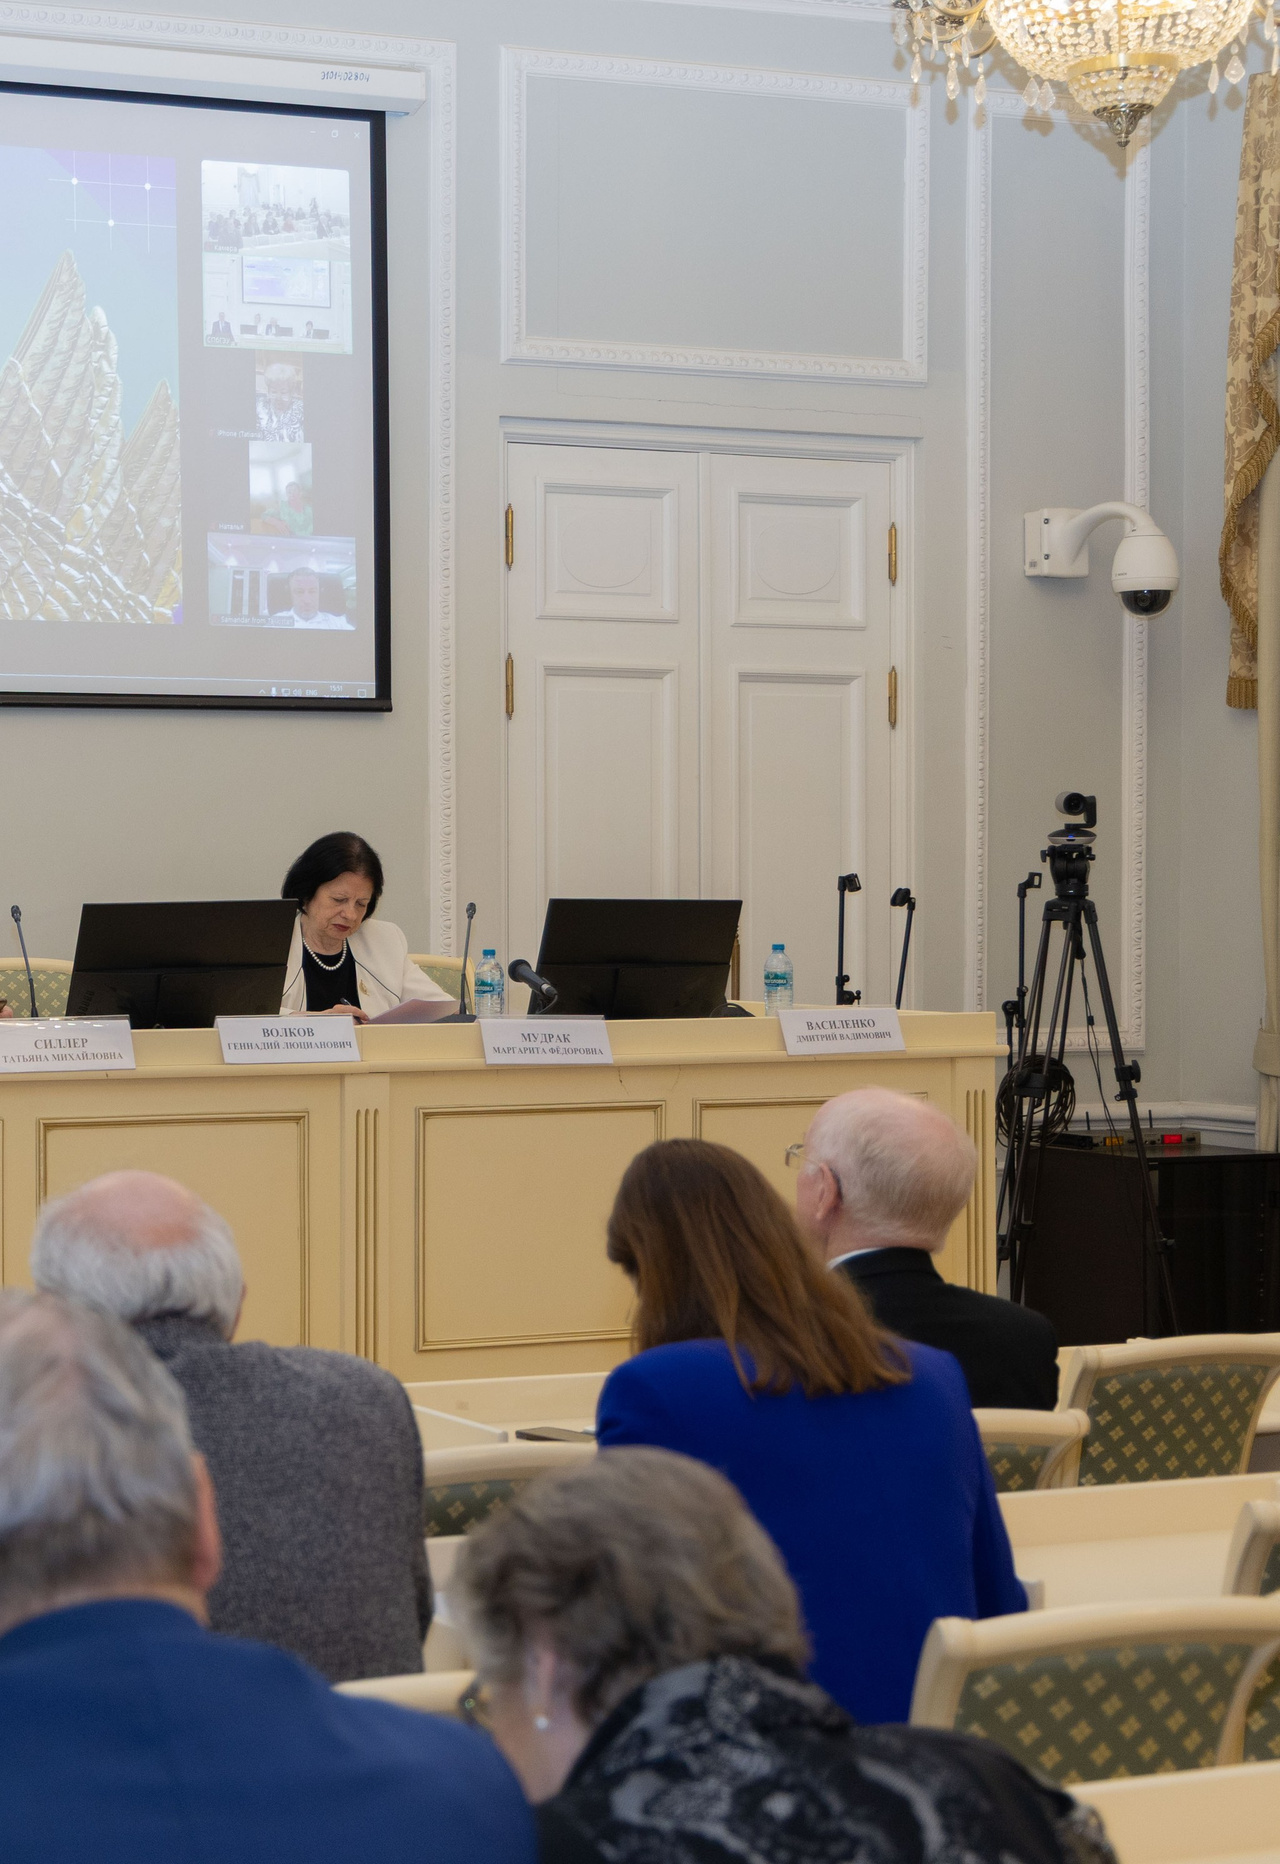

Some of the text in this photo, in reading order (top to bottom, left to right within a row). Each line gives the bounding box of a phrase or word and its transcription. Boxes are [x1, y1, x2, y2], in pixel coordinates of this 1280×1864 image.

[806, 1018, 876, 1031] ВАСИЛЕНКО
[262, 1027, 315, 1038] ВОЛКОВ
[796, 1031, 891, 1043] ДМИТРИЙ ВАДИМОВИЧ
[34, 1038, 88, 1049] СИЛЛЕР
[521, 1033, 571, 1044] МУДРАК
[228, 1040, 352, 1050] ГЕННАДИЙ ЛЮЦИАНОВИЧ
[493, 1046, 604, 1056] МАРГАРИТА ФЁДОРОВНА
[2, 1051, 123, 1063] ТАТЬЯНА МИХАЙЛОВНА
